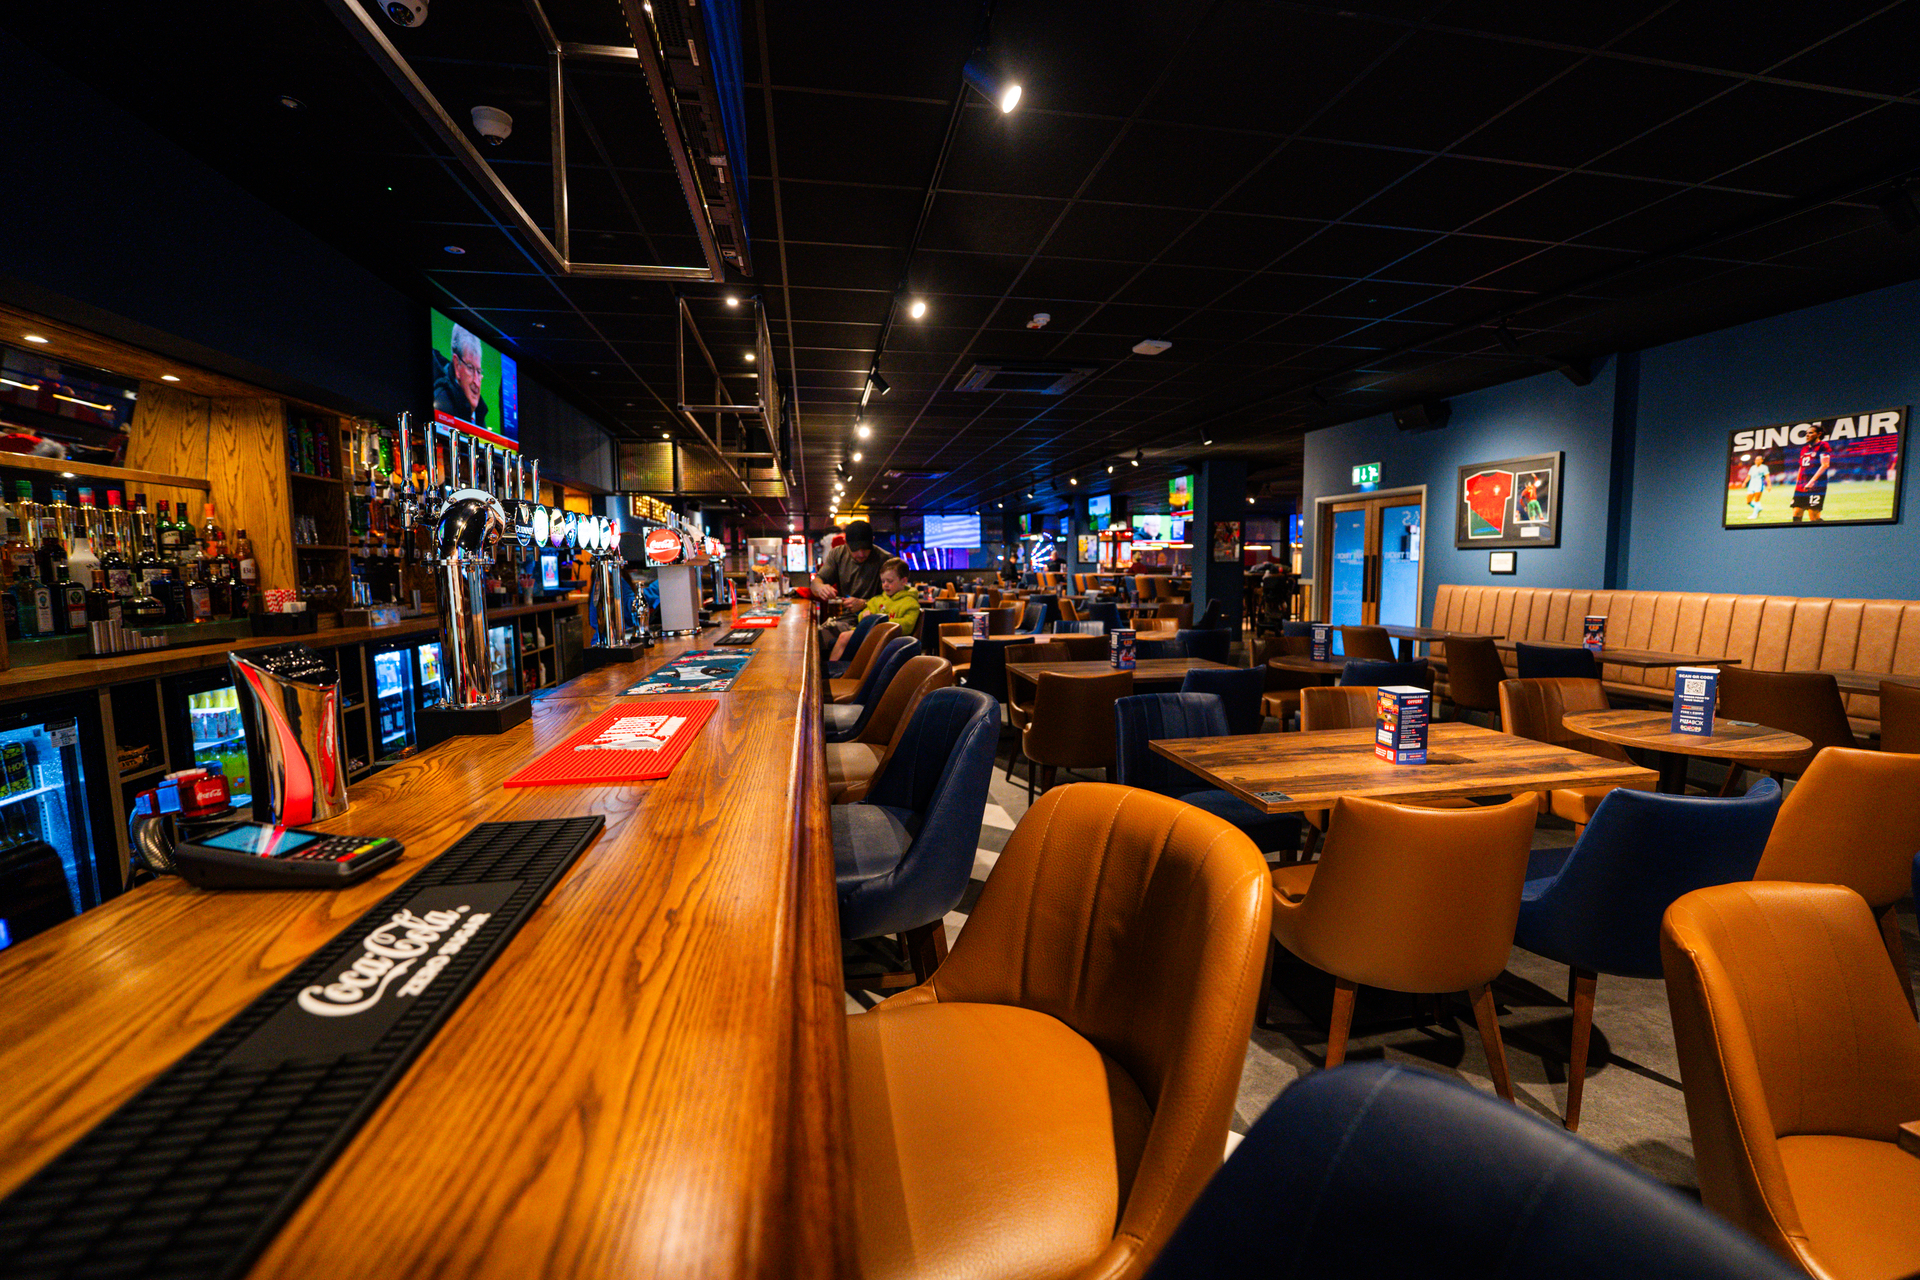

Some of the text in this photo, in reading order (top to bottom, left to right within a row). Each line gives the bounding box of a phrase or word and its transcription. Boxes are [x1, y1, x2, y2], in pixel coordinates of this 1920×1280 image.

[1802, 456, 1811, 467] 12
[1809, 495, 1820, 504] 12
[7, 759, 28, 773] HOO
[197, 789, 222, 801] Coca-Cola
[297, 908, 462, 1017] Coca-Cola
[396, 955, 451, 998] ZERO
